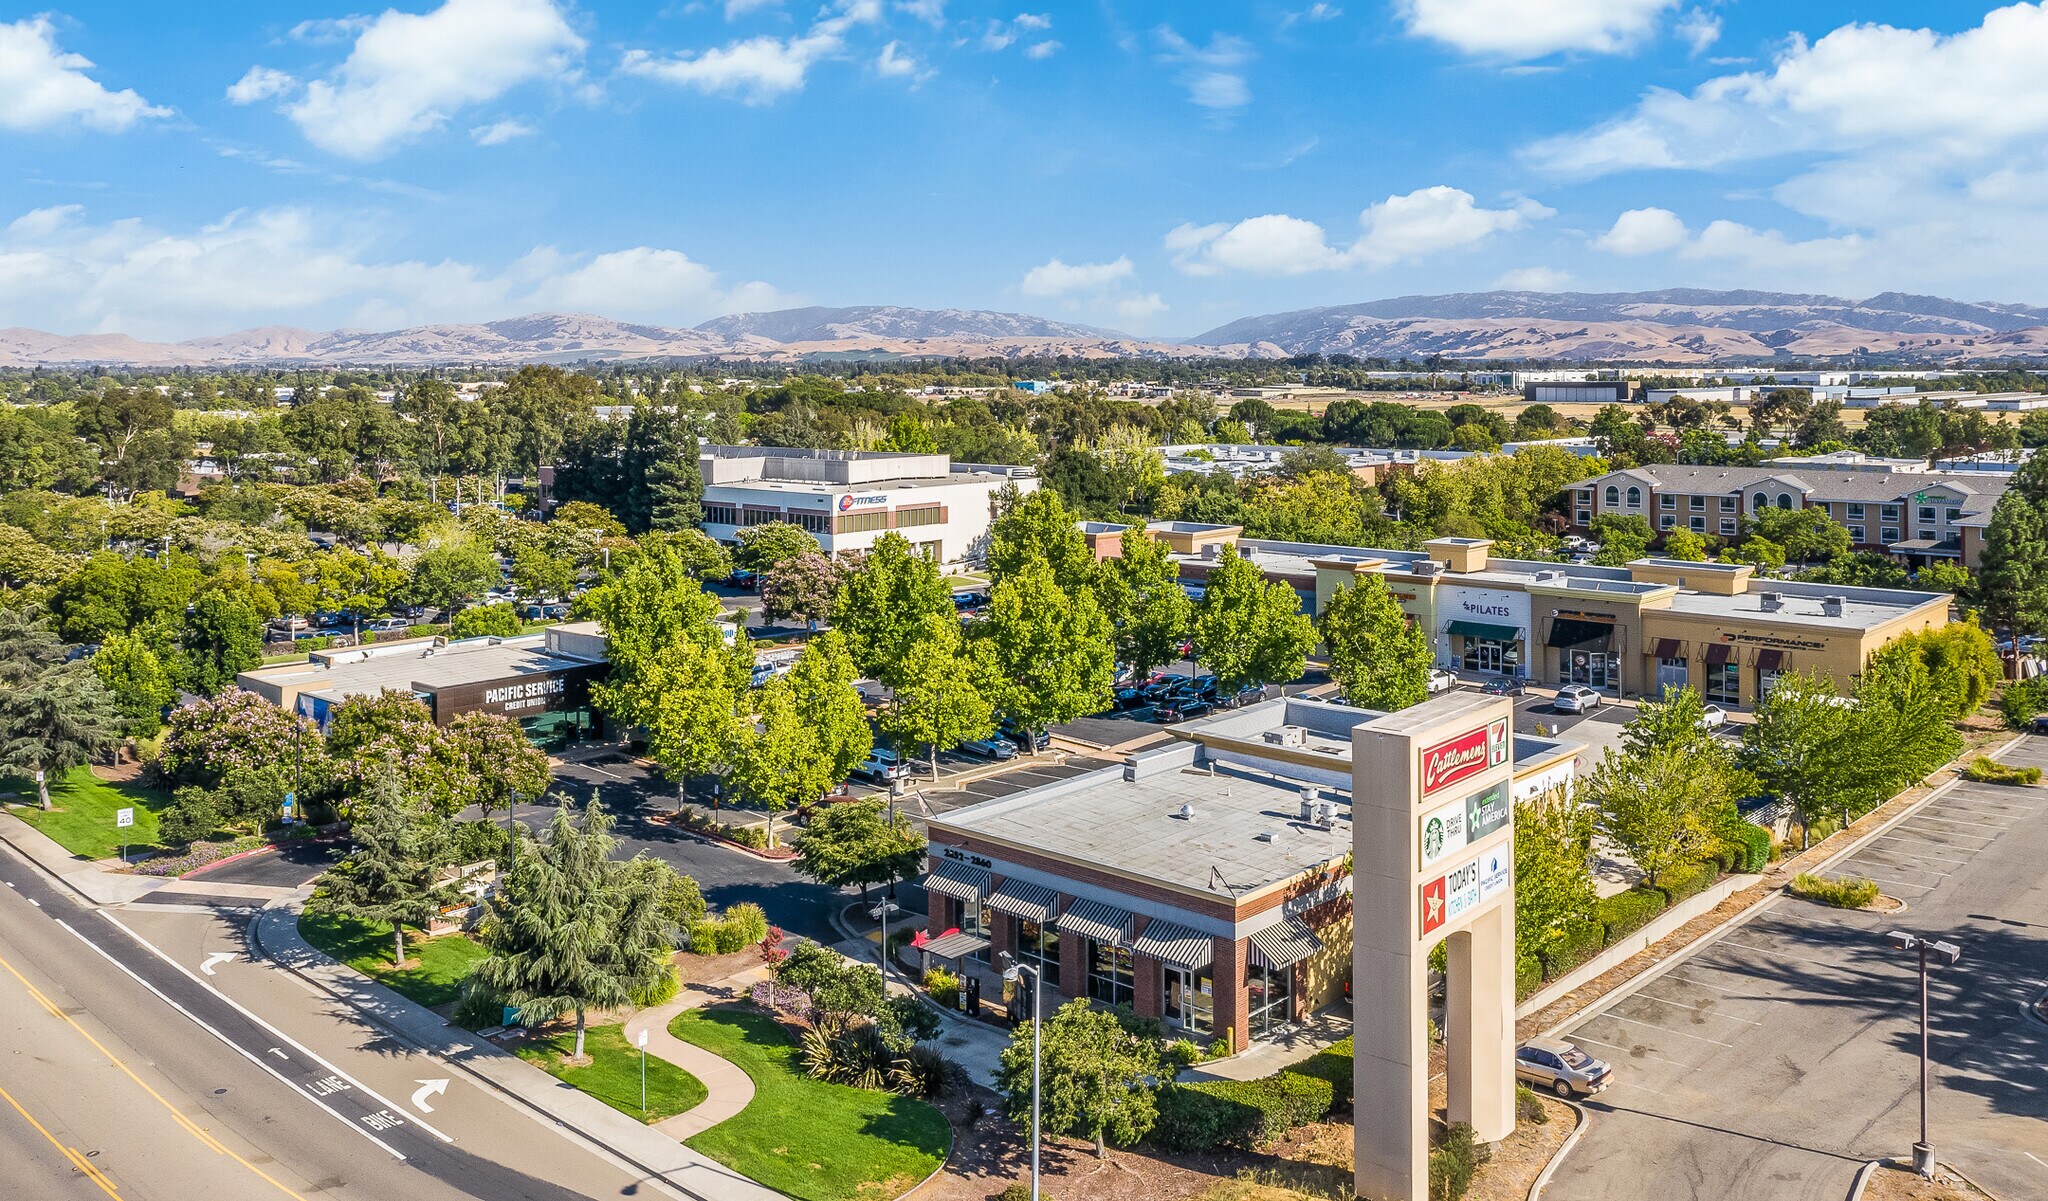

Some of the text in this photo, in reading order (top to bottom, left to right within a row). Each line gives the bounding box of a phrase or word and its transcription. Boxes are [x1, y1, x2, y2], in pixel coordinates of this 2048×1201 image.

[853, 495, 888, 505] FITNESS
[1470, 604, 1510, 617] PILATES
[485, 678, 564, 704] PACIFIC SERVICE
[504, 699, 526, 711] CREDIT
[1426, 740, 1486, 788] Cattlemens
[1481, 801, 1495, 817] STAY
[1481, 806, 1508, 827] AMERICA
[119, 816, 132, 824] 40
[1446, 813, 1462, 829] DRIVE
[1447, 823, 1461, 839] THRU
[1448, 862, 1476, 895] TODAY'S
[305, 1075, 351, 1097] LANE
[360, 1109, 404, 1131] BIKE
